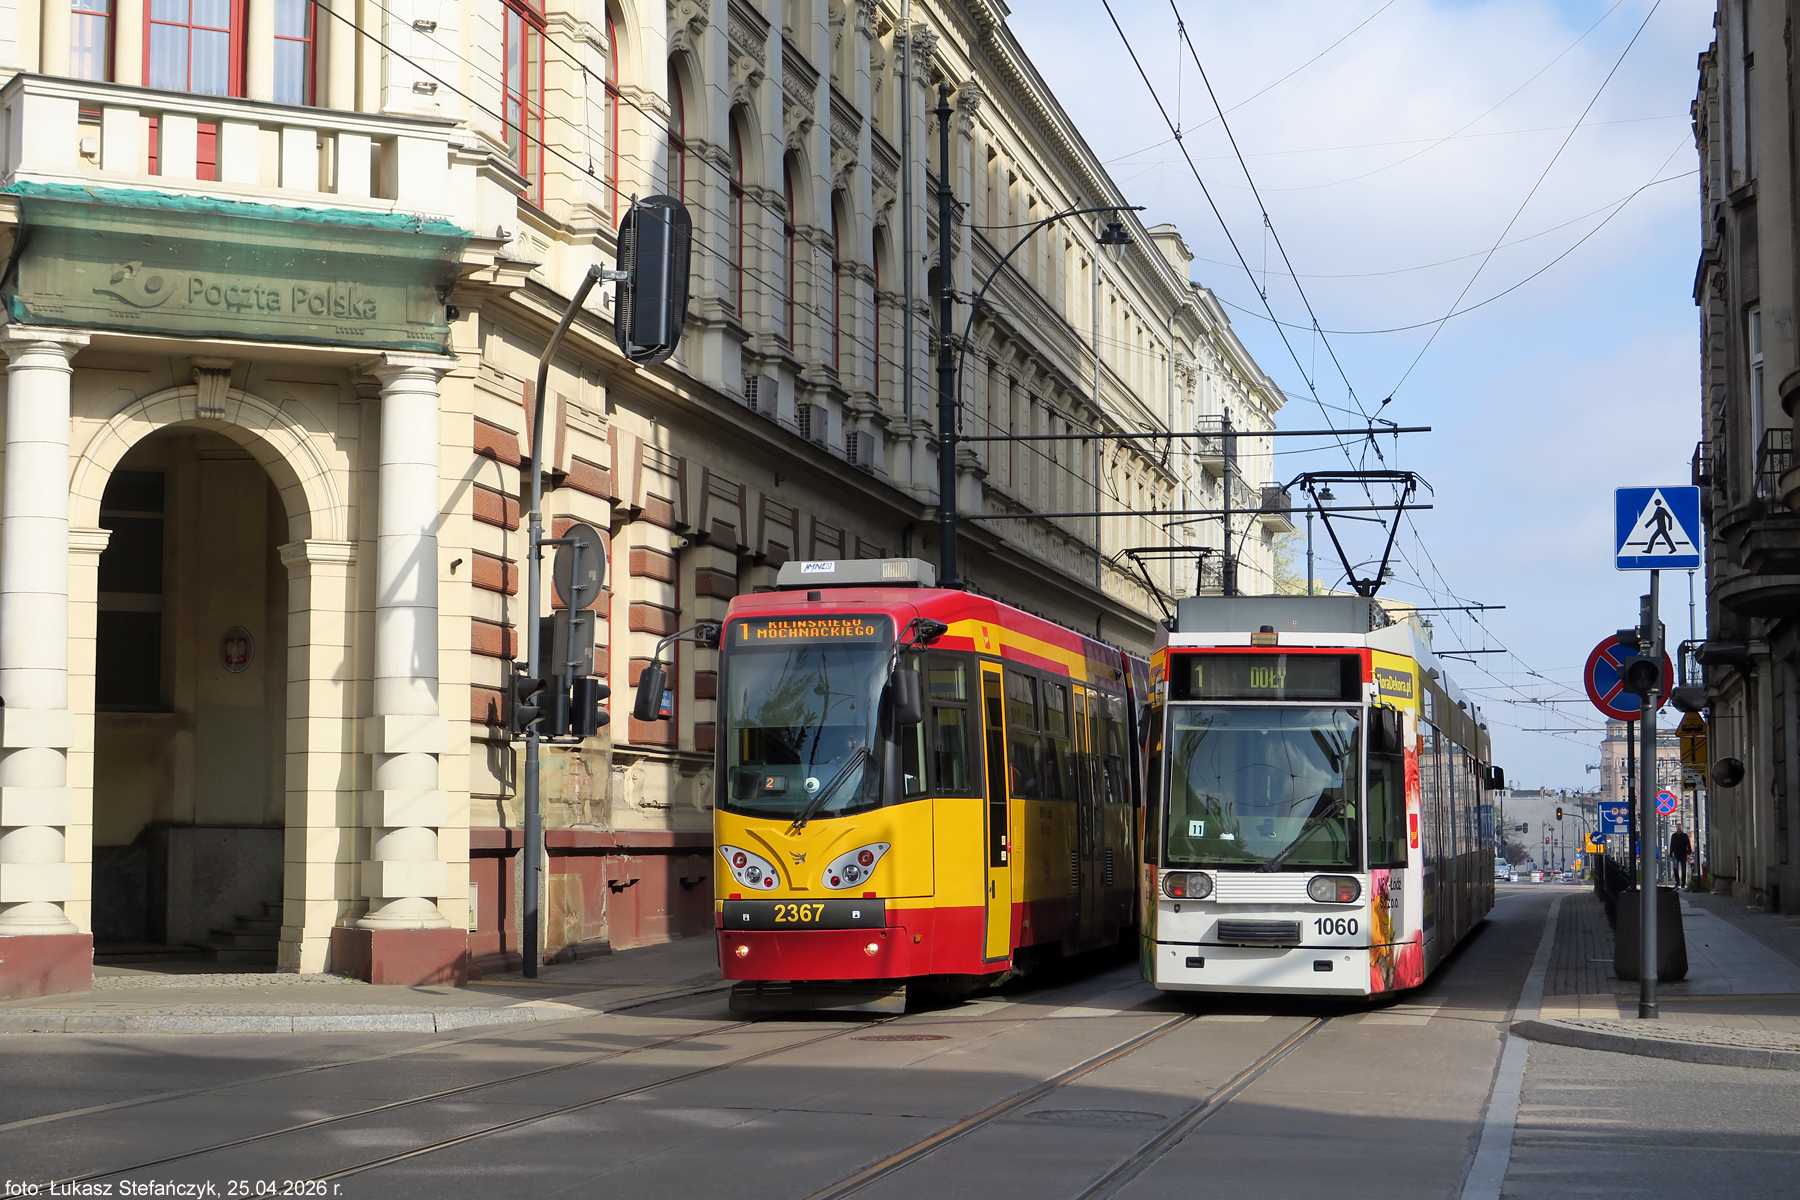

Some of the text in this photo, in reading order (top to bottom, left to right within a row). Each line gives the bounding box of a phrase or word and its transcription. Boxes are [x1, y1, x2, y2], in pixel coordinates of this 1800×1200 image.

[188, 276, 377, 320] Poczta Polska
[739, 623, 749, 640] 1
[756, 625, 875, 639] MOCHNACKIEGO
[1195, 665, 1287, 689] 1 DOŁY
[765, 777, 775, 788] 2
[1192, 824, 1202, 835] 11
[774, 903, 825, 922] 2367
[1314, 917, 1359, 936] 1060
